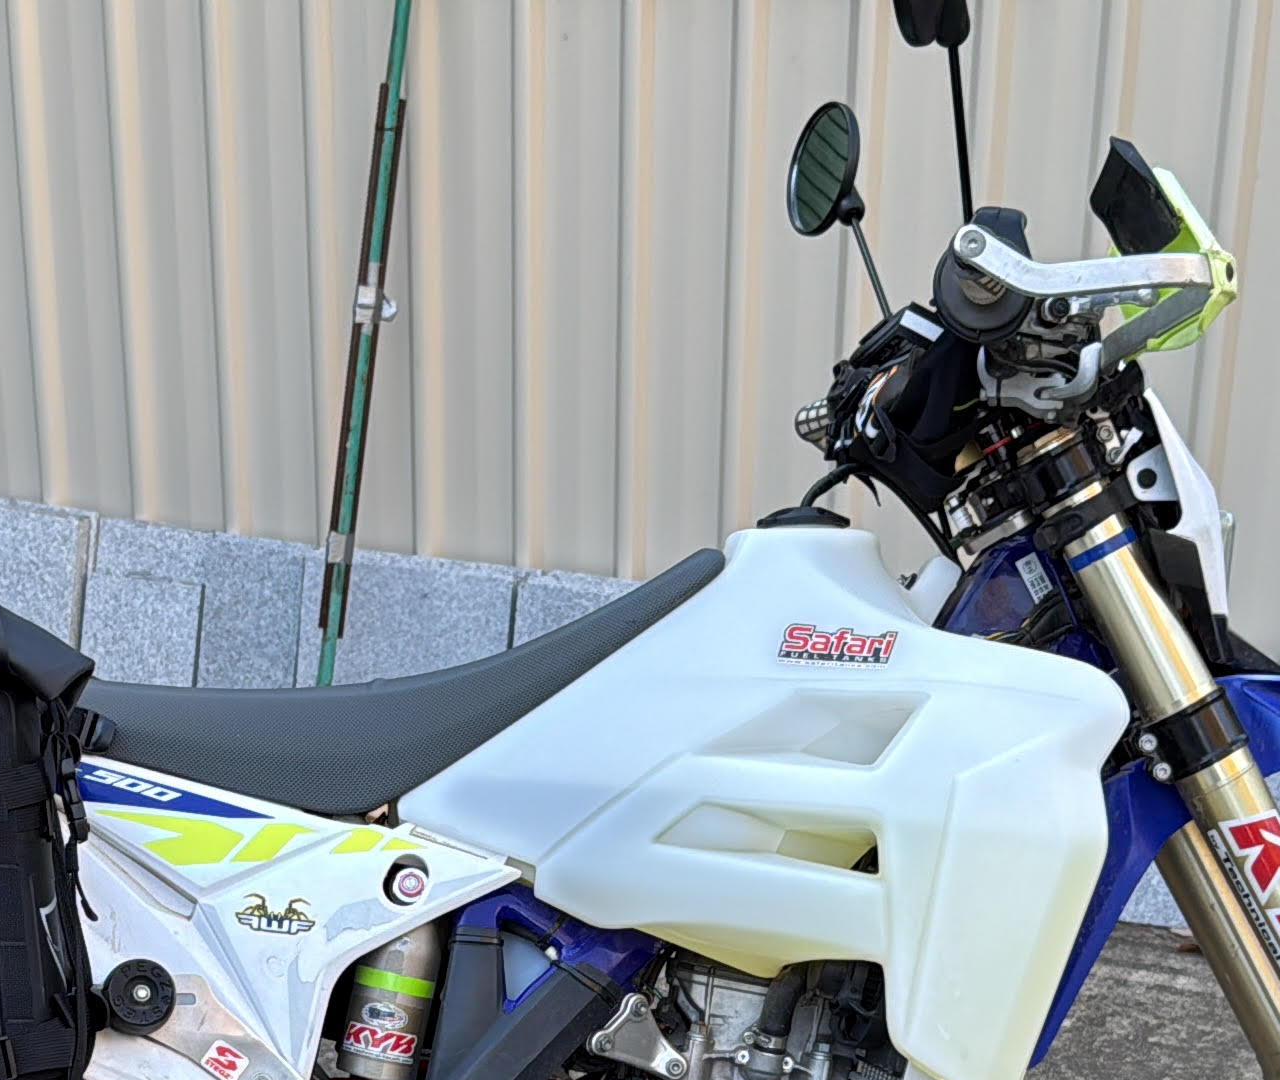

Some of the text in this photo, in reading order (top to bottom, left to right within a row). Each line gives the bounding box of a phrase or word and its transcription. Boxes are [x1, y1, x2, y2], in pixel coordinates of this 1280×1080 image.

[782, 623, 898, 657] Safari
[82, 769, 183, 802] 500
[344, 1022, 417, 1056] KYB
